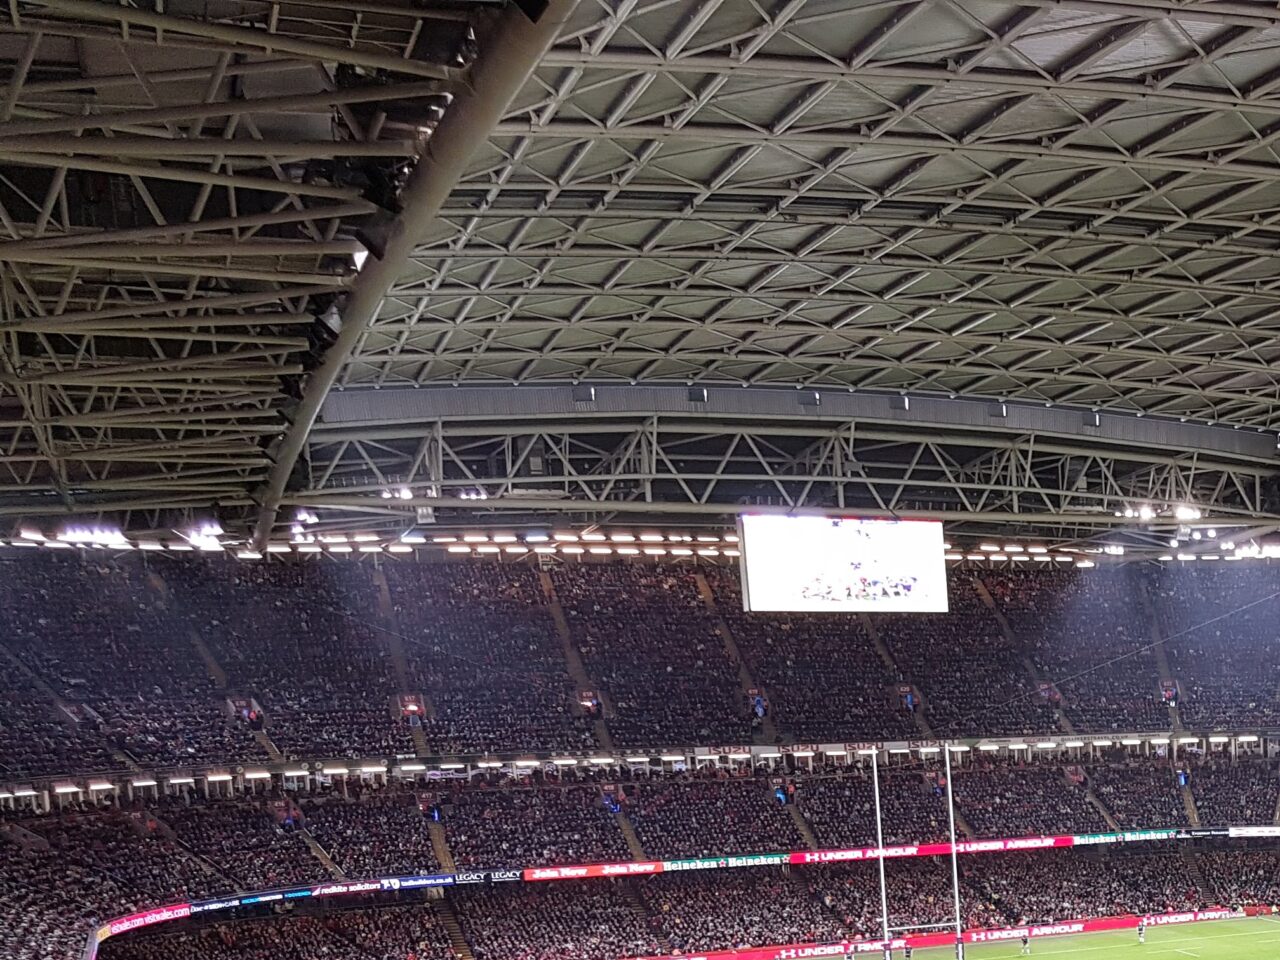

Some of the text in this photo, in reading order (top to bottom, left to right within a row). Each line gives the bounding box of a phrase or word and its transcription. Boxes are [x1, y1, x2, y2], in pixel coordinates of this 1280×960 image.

[708, 746, 750, 754] ISUZU
[778, 744, 819, 753] ISUZU
[844, 742, 884, 750] ISUZU
[1073, 834, 1116, 845] Heineken
[1125, 831, 1168, 842] Heineken
[965, 838, 1055, 851] UNDER ARMOUR
[821, 850, 863, 861] UNDER
[663, 859, 718, 871] Heineken
[728, 856, 780, 867] Heineken
[532, 867, 587, 878] Join Now
[602, 863, 656, 875] Join Now
[349, 882, 381, 892] solicitors
[1157, 912, 1194, 924] UNDER
[987, 923, 1084, 940] UNDER ARMOUR
[798, 944, 845, 957] UNDER
